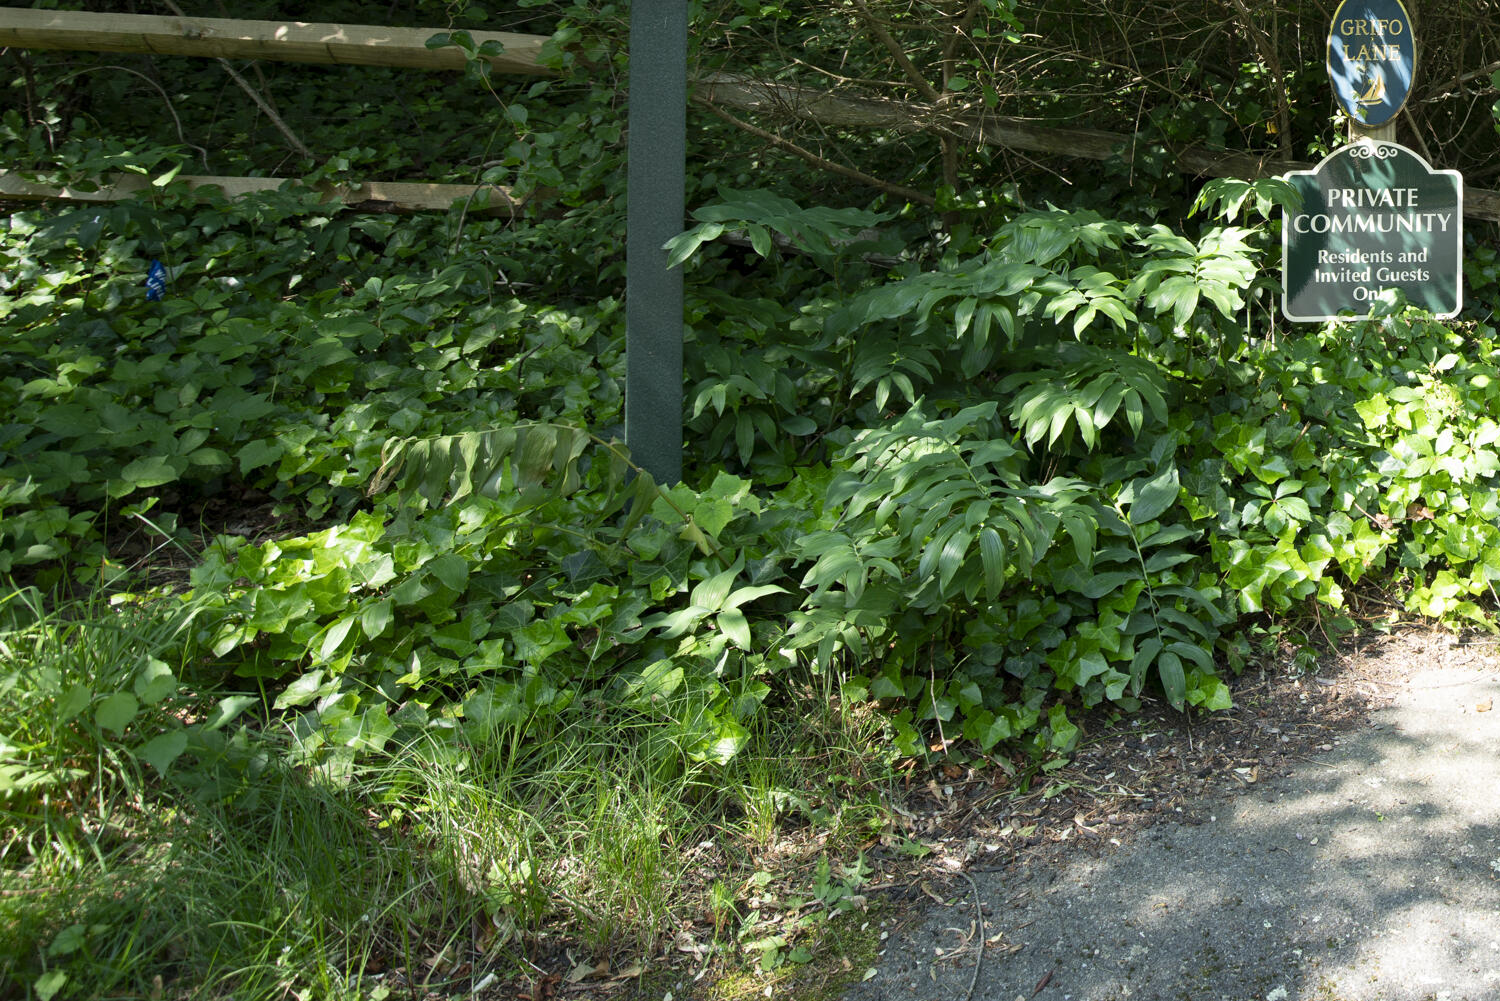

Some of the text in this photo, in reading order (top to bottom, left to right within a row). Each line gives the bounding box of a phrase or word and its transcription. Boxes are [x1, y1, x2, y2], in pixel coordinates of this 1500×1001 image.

[1339, 18, 1404, 37] GRIFO
[1342, 44, 1402, 62] LANE
[1327, 187, 1419, 208] PRIVATE
[1293, 212, 1452, 235] COMMUNITY
[1317, 247, 1428, 264] Residents and
[1314, 267, 1430, 284] Invited Guests
